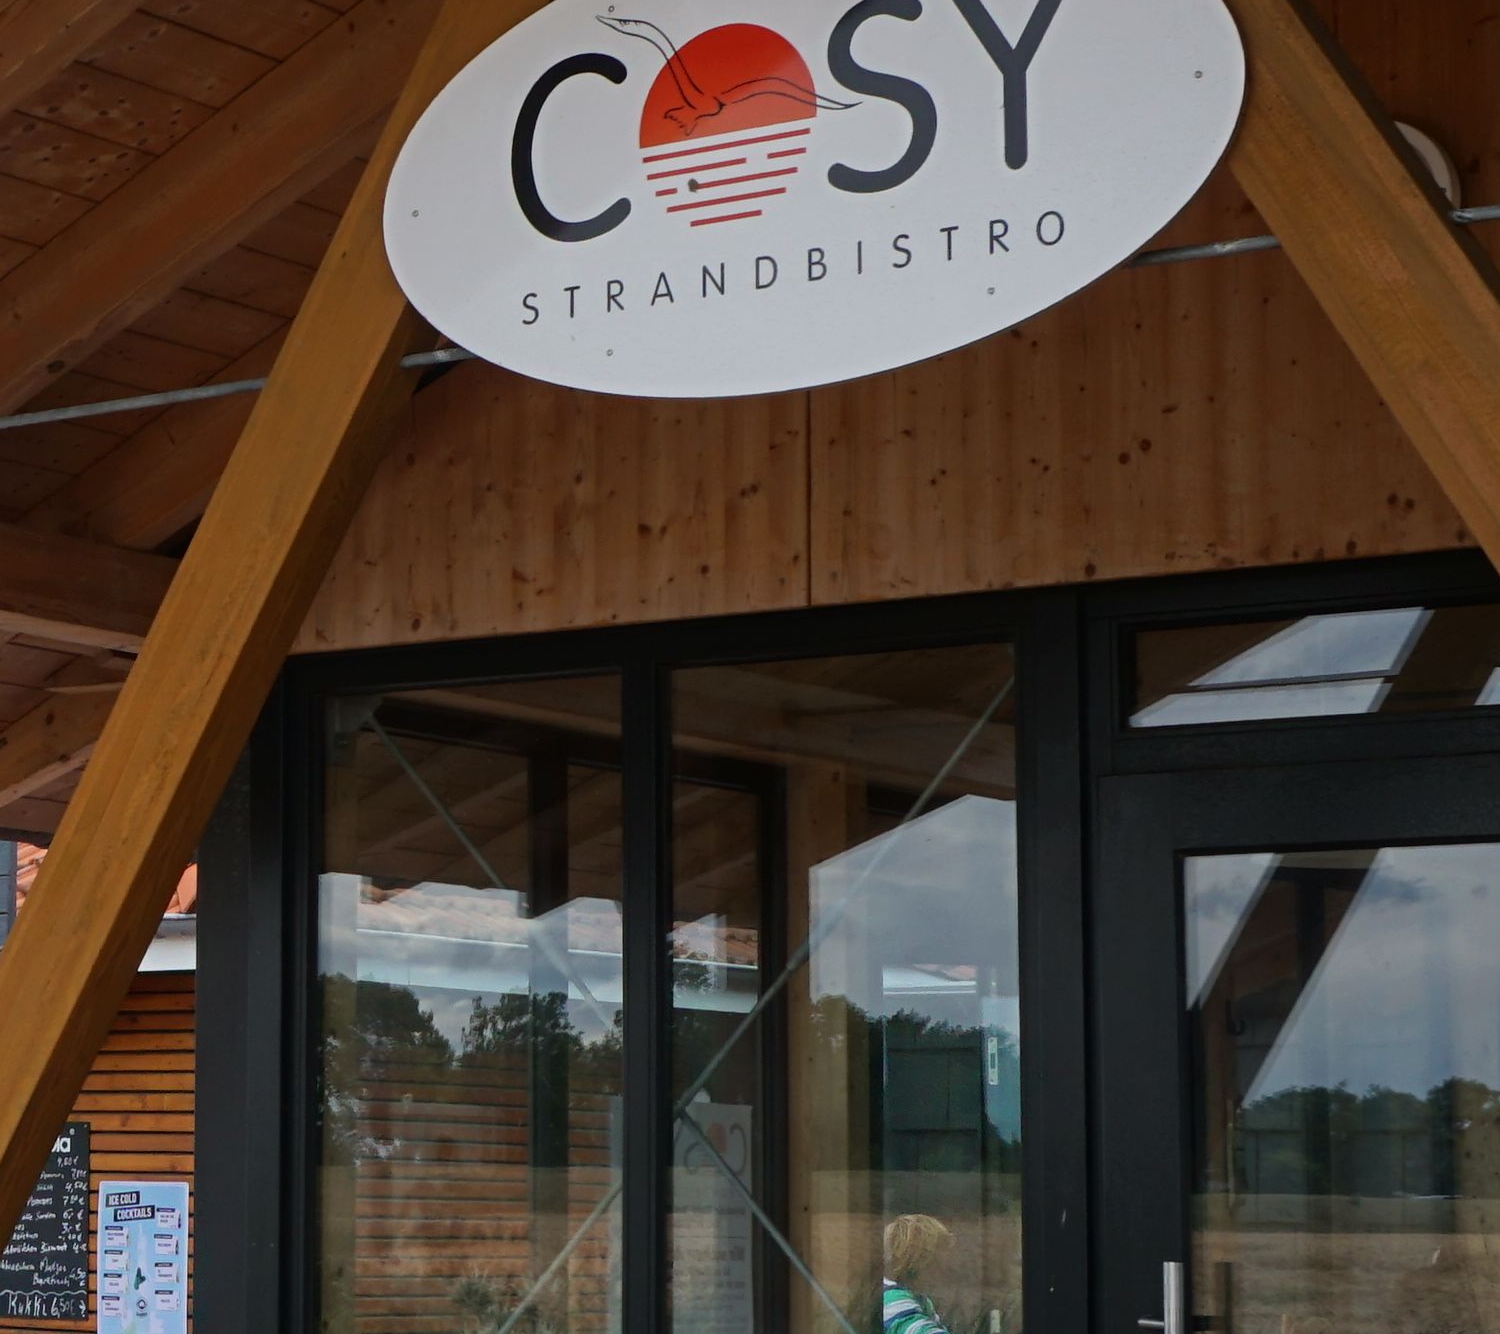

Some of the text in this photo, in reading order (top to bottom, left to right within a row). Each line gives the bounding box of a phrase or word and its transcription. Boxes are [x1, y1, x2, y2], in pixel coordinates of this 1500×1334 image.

[521, 211, 1066, 326] STRANDBISTRO
[108, 1193, 137, 1206] ICE COLD
[117, 1208, 152, 1220] COCKTAILS
